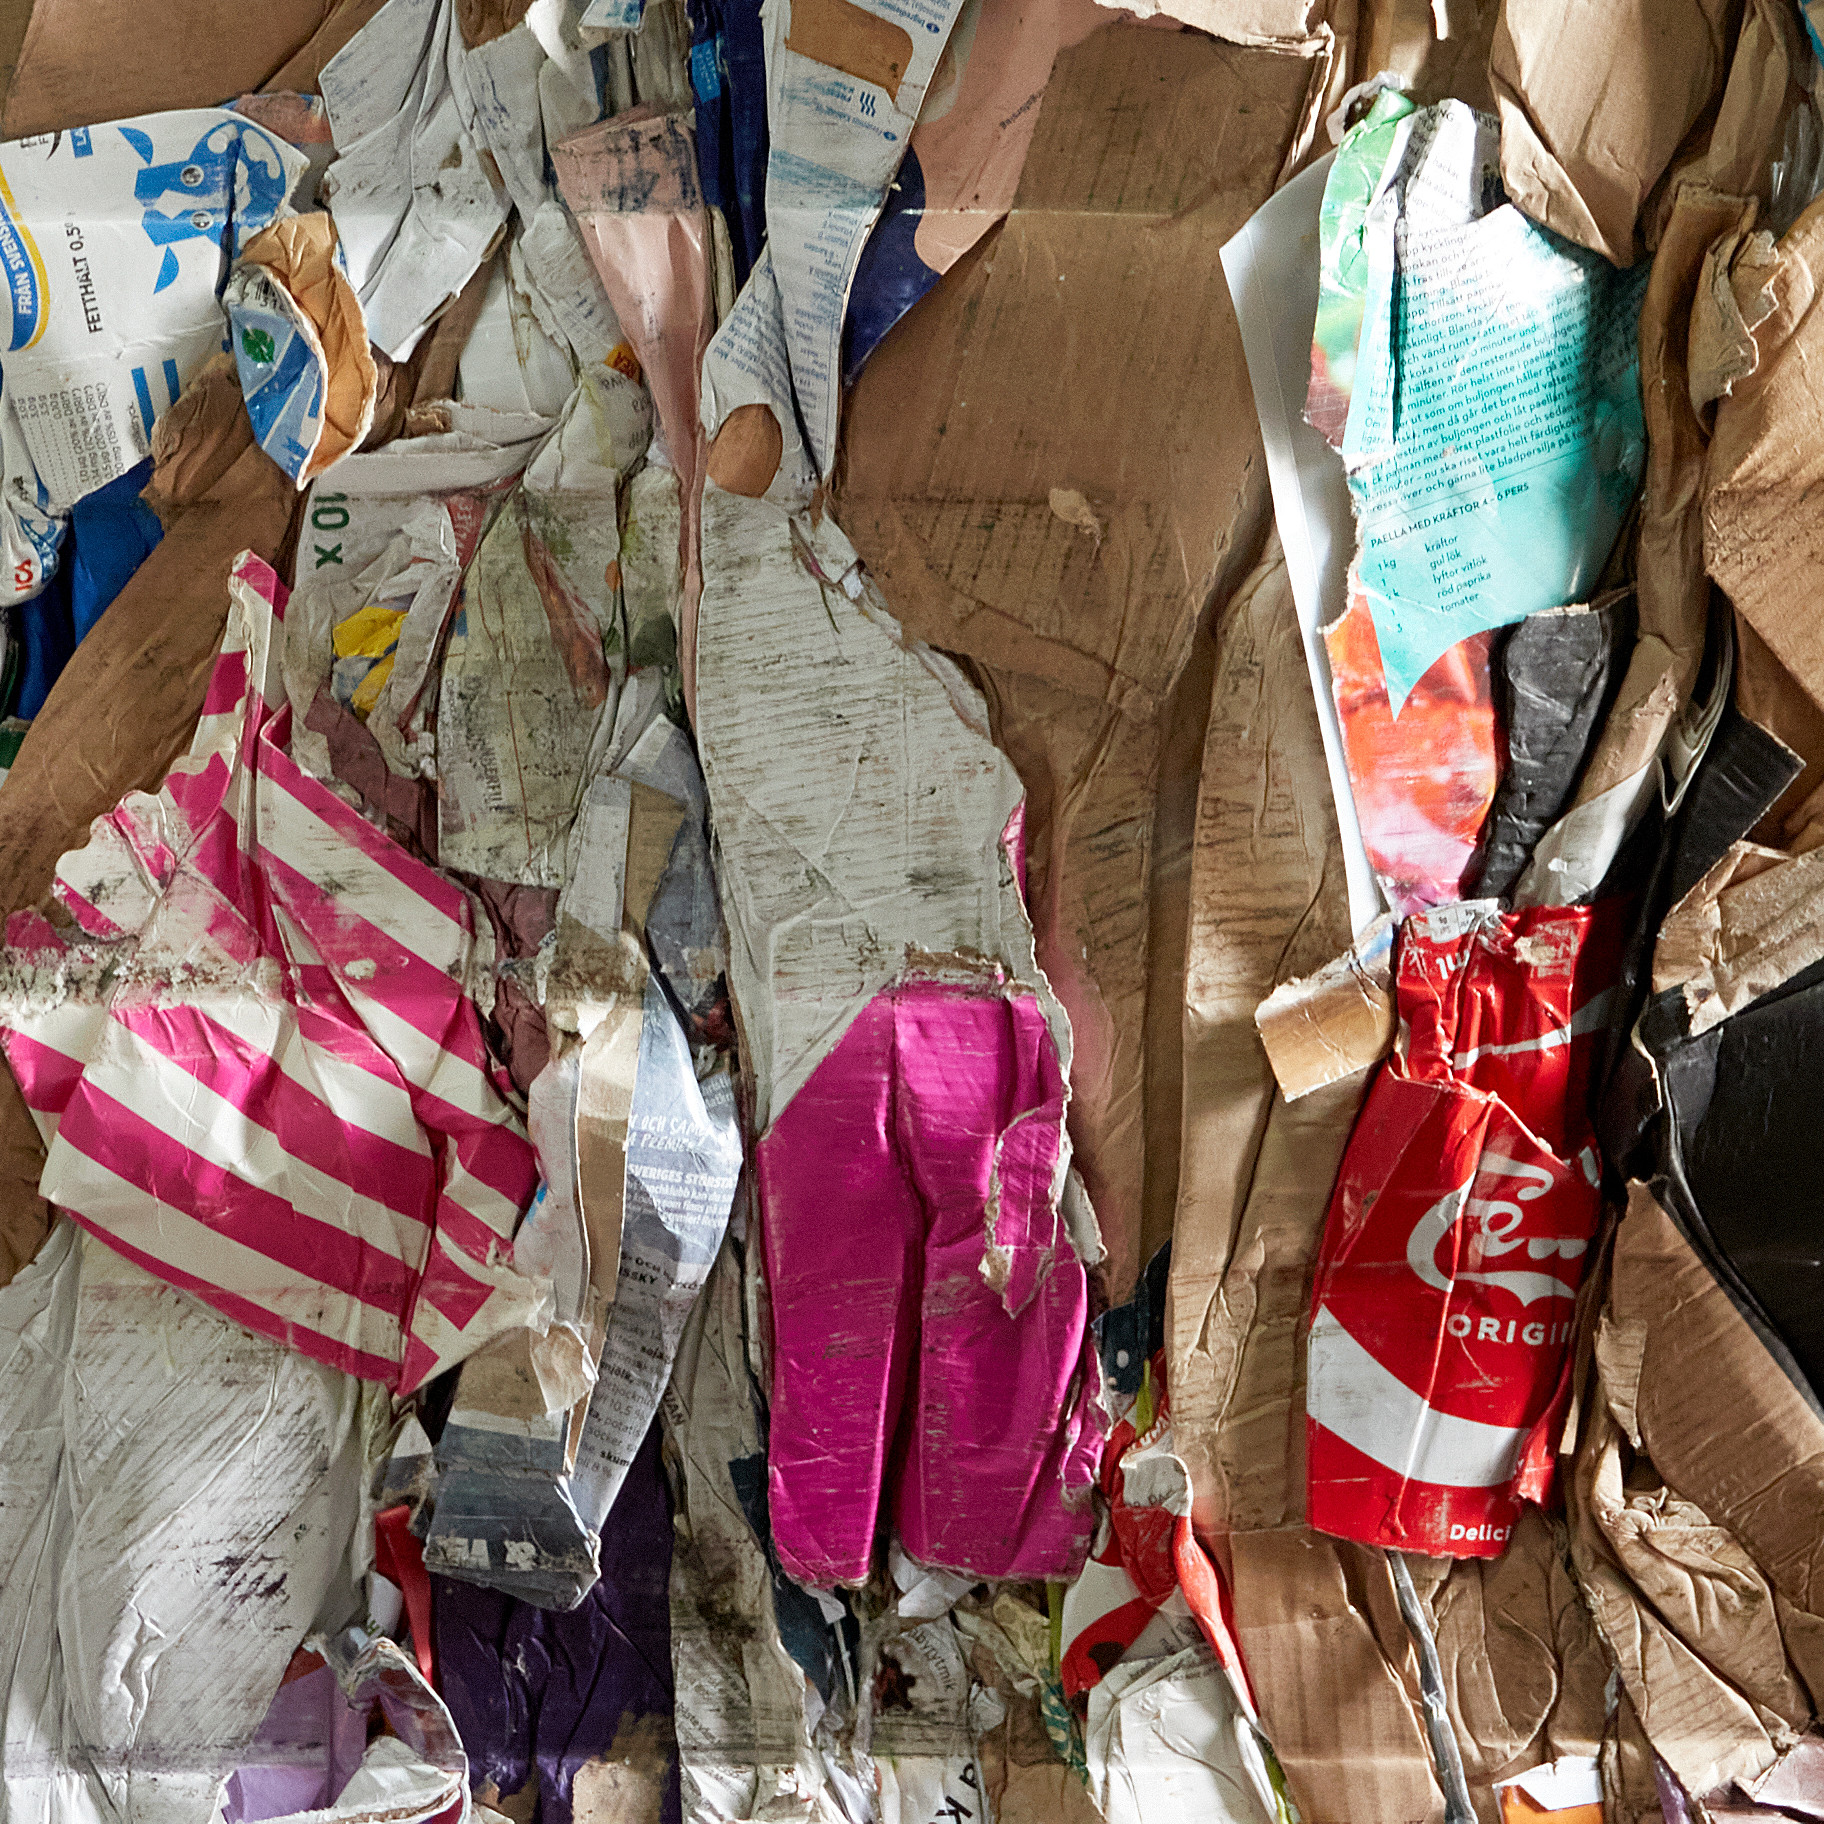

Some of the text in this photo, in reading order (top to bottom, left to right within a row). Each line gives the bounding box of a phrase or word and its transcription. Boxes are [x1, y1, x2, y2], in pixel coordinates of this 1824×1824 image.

[11, 272, 35, 315] FRÅN
[69, 253, 106, 335] FETTHALT
[1447, 318, 1483, 336] Blanda
[1409, 332, 1517, 380] koka minuter
[1421, 336, 1469, 360] vänd runt
[1407, 376, 1444, 395] hälften
[1478, 344, 1533, 370] resterande
[1468, 362, 1516, 387] helst inte
[1423, 405, 1446, 420] som
[1464, 379, 1514, 407] buljongen
[1513, 367, 1544, 386] håller
[1528, 389, 1564, 412] paellan
[1421, 419, 1446, 435] men
[1460, 405, 1480, 423] går
[1478, 397, 1498, 414] det
[1498, 391, 1517, 406] bra
[1517, 384, 1541, 400] med
[1543, 402, 1573, 420] sedan
[1439, 417, 1492, 445] buljongen
[1492, 409, 1513, 425] och
[1473, 414, 1542, 449] plastfolie och
[1529, 413, 1581, 440] färdigkokt
[1424, 478, 1445, 493] och
[1445, 467, 1478, 488] gärna
[1496, 440, 1556, 469] bladpersilja
[1438, 459, 1457, 473] ska
[1458, 452, 1482, 467] riset
[1483, 443, 1506, 458] vara
[1506, 433, 1528, 449] helt
[310, 492, 349, 530] 10
[1369, 528, 1408, 548] PAELLA
[1407, 516, 1432, 532] MED
[1431, 499, 1481, 524] KRÄFTOR
[1503, 482, 1530, 499] PERS
[1424, 533, 1459, 553] kräftor
[1427, 553, 1446, 570] gul
[1459, 554, 1487, 573] vitlök
[1454, 570, 1492, 592] paprika
[1440, 592, 1480, 613] tomater
[641, 1114, 666, 1132] OCH
[627, 1163, 683, 1183] SVERIGES
